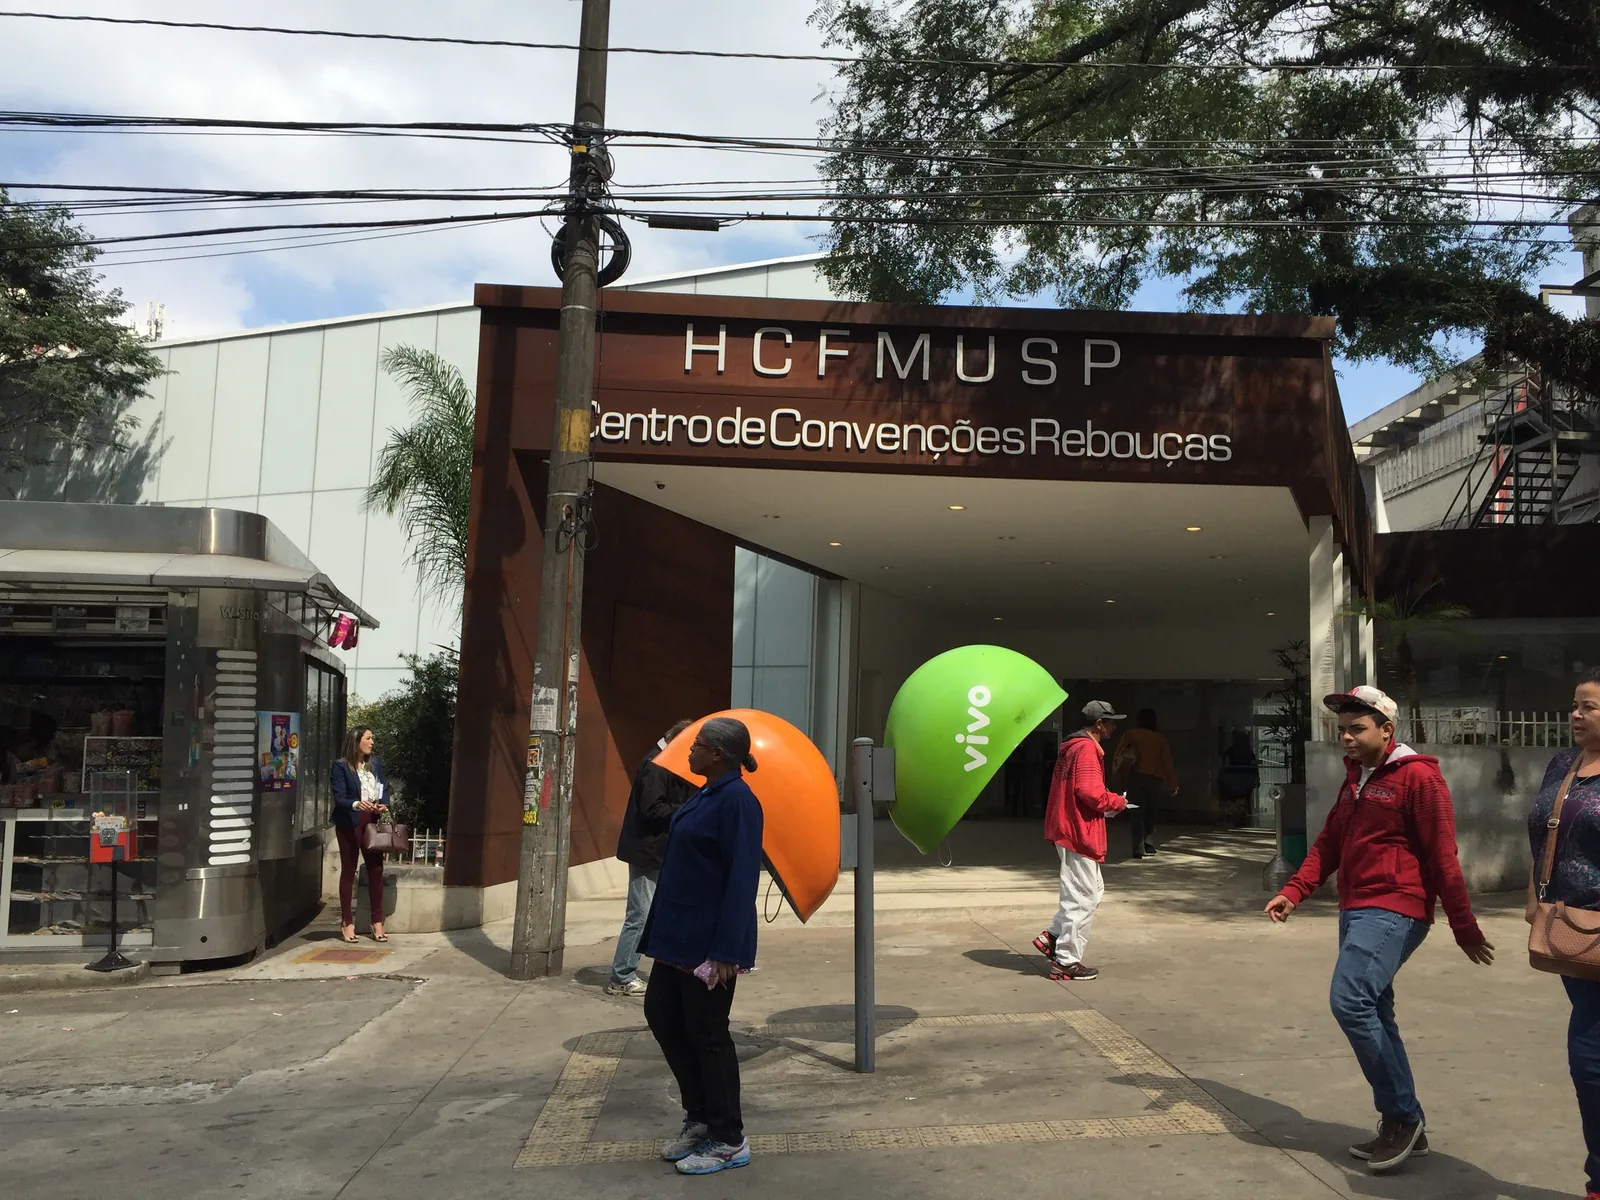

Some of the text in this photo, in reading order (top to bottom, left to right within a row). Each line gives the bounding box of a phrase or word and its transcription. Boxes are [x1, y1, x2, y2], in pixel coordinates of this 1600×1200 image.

[684, 323, 1122, 386] HCFMUSP
[716, 406, 766, 446] de
[770, 408, 1026, 461] Convenções
[1030, 418, 1232, 467] Rebouças
[955, 685, 992, 772] vivo
